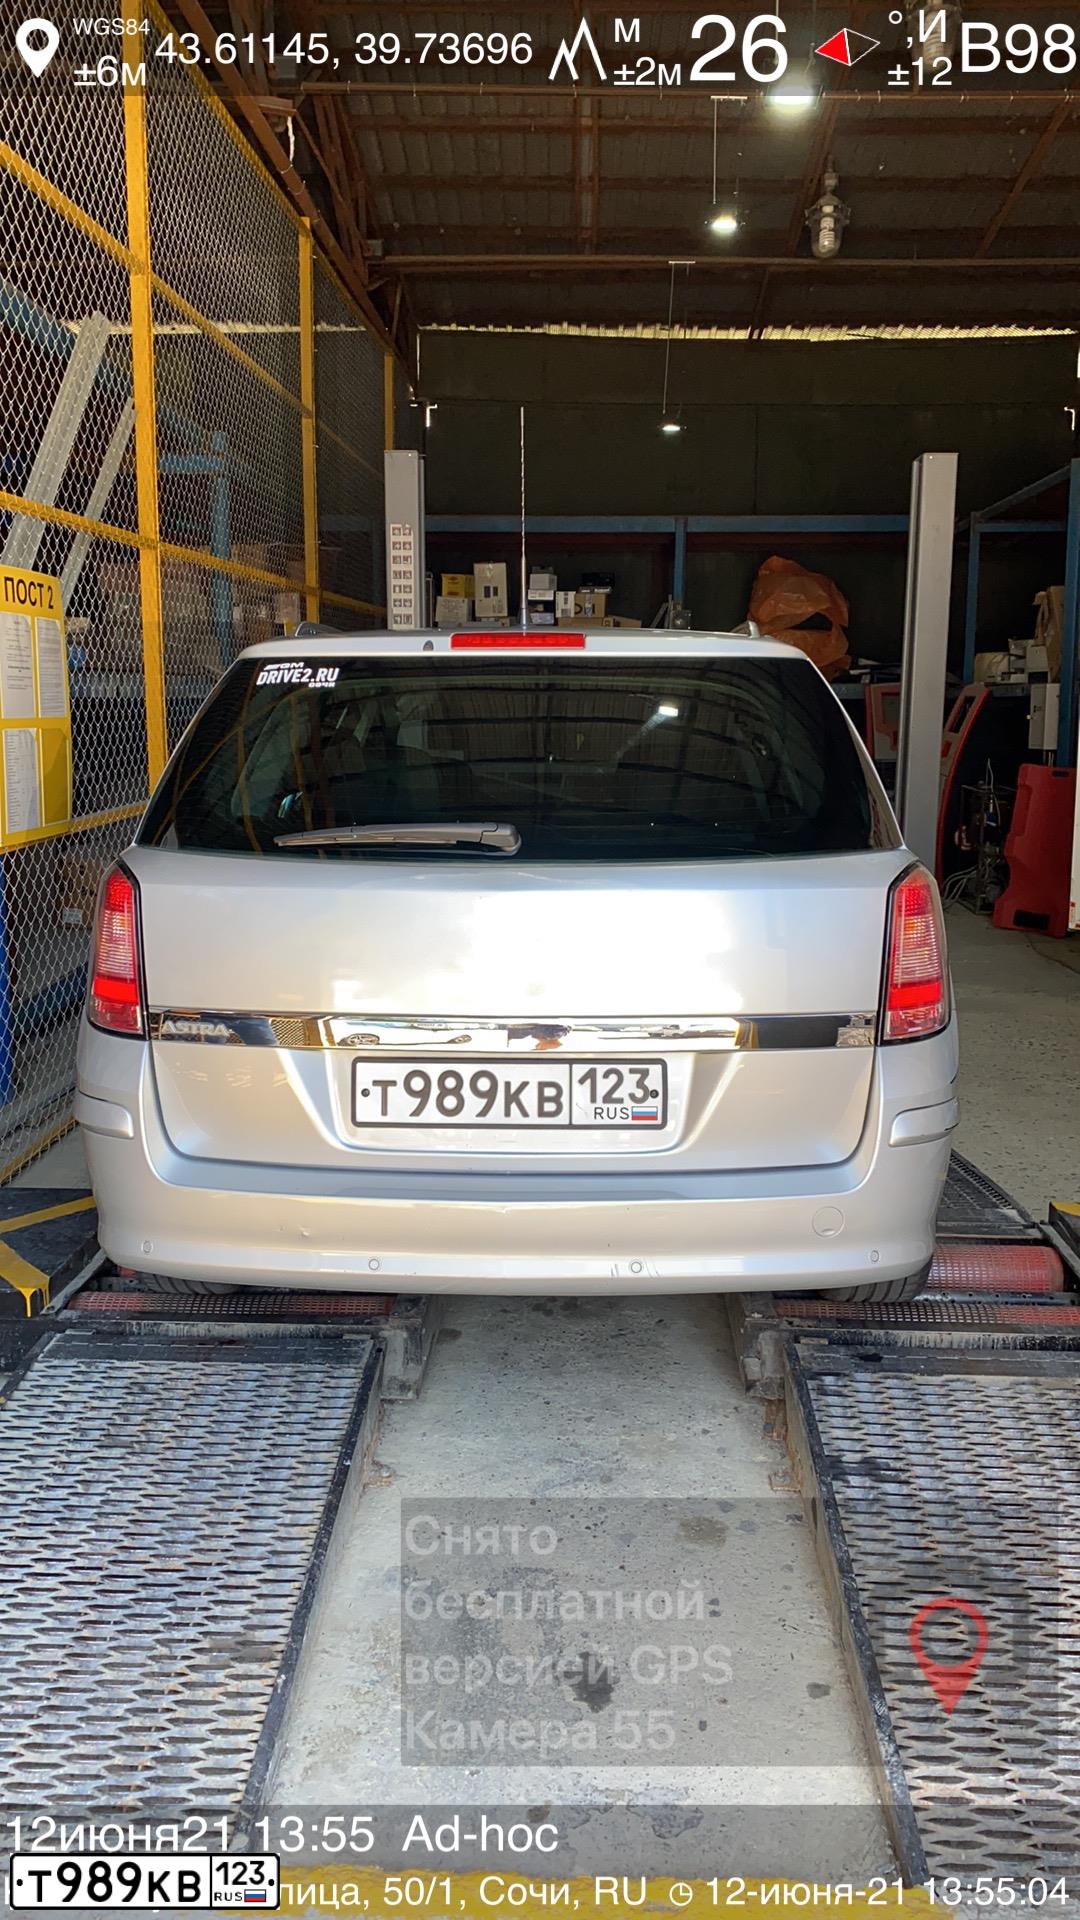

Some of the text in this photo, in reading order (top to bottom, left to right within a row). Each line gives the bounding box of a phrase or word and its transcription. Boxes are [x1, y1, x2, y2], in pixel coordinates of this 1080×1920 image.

[4, 576, 54, 609] ПОСТ 2
[256, 667, 340, 686] DRIVE2.RU
[161, 1020, 231, 1037] ASTRA
[372, 1069, 563, 1118] Т989КВ
[577, 1067, 650, 1104] 123
[594, 1107, 629, 1120] RUS
